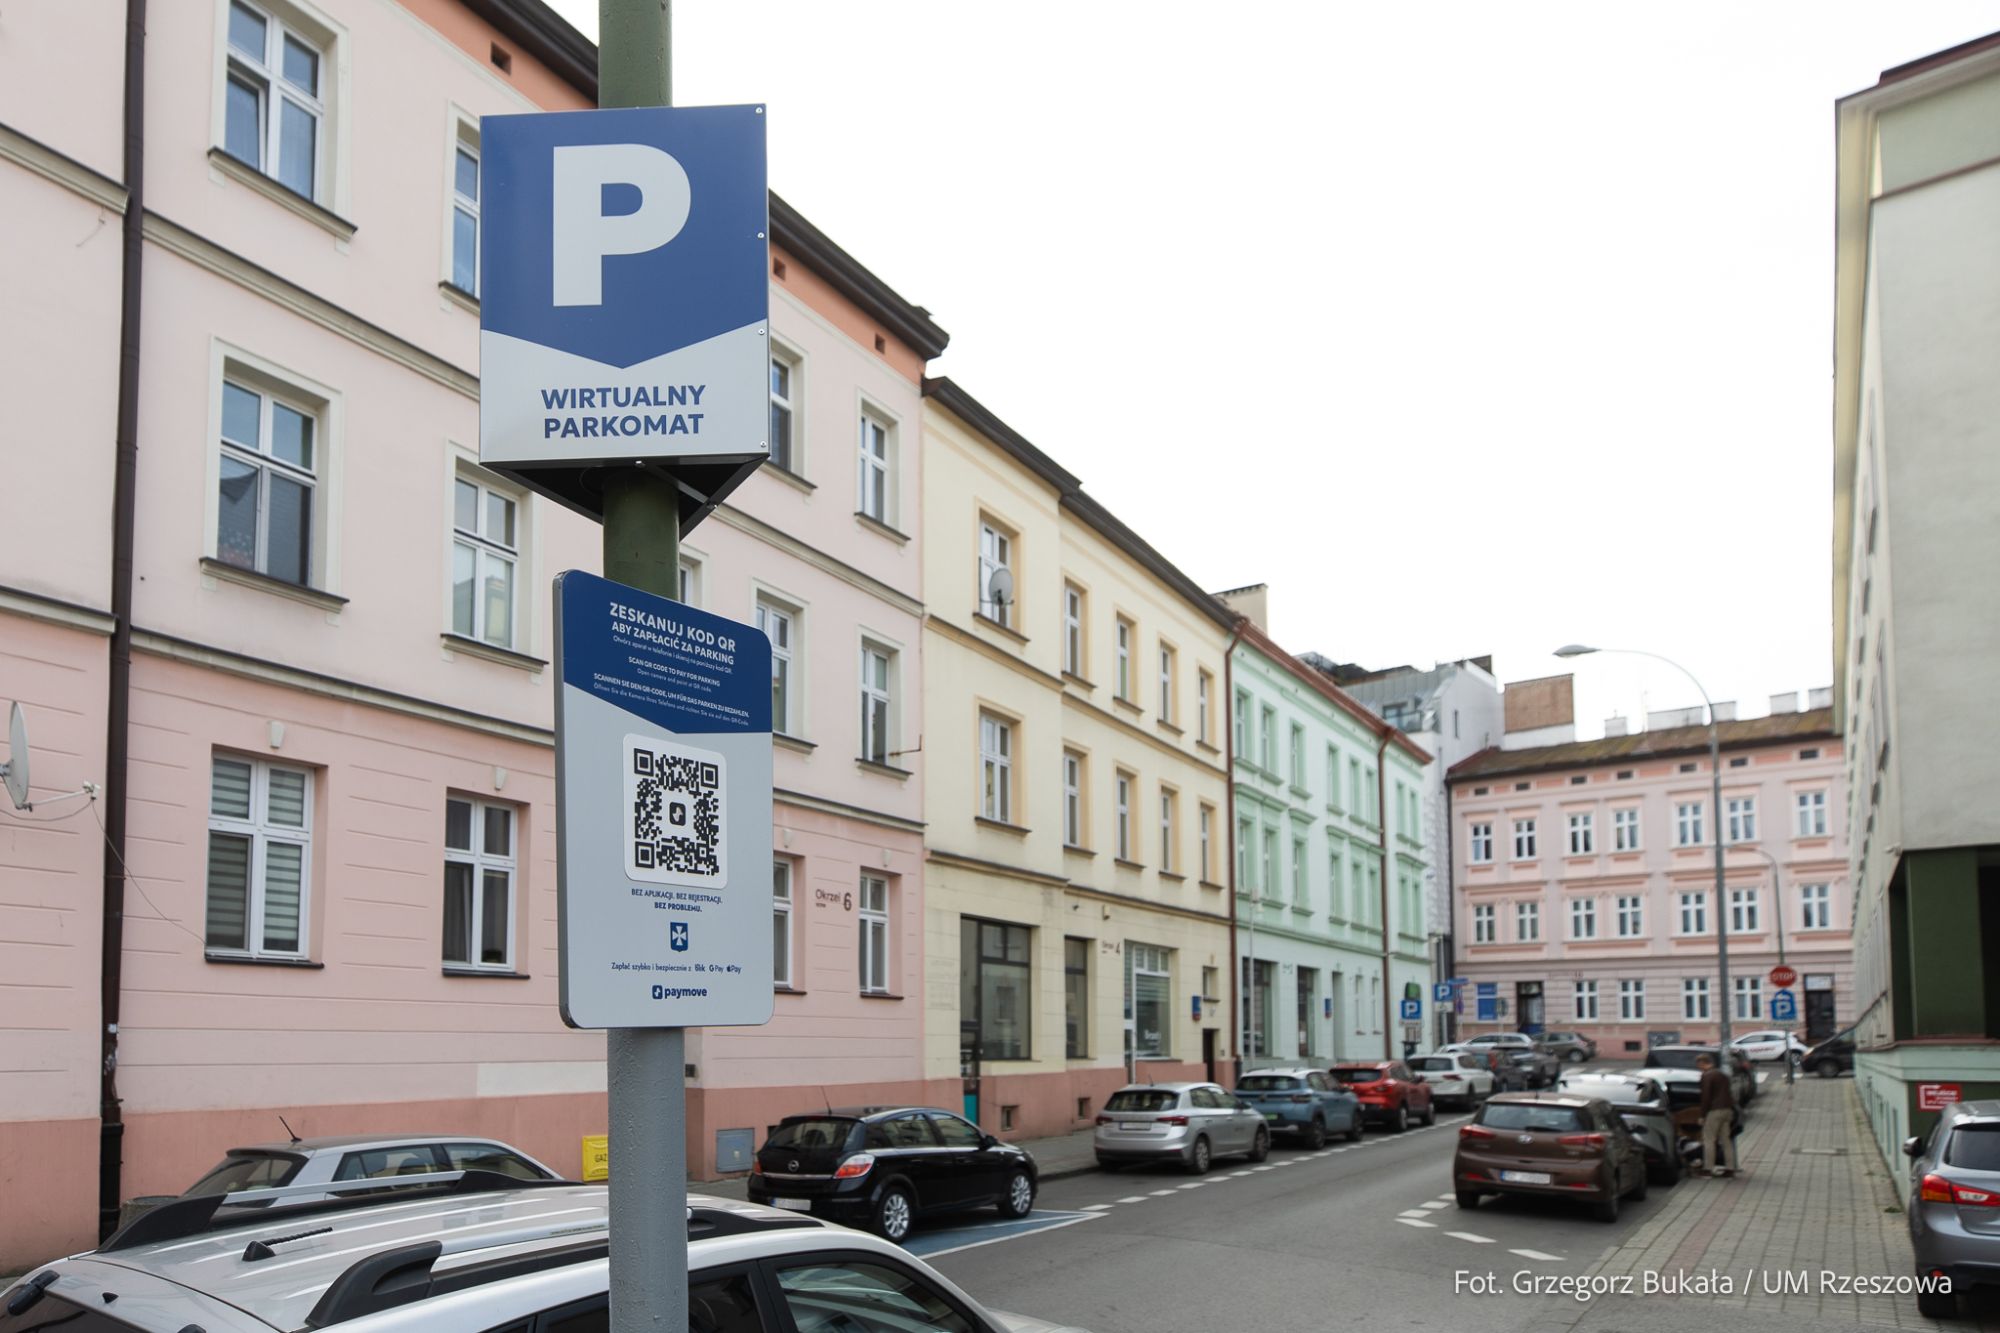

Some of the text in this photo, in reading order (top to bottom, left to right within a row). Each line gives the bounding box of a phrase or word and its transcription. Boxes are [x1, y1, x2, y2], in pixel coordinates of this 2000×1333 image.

[553, 143, 691, 307] P
[541, 385, 706, 410] WIRTUALNY
[544, 413, 704, 439] PARKOMAT
[609, 602, 736, 653] ZESKANUJ KOD QR
[611, 620, 735, 665] ABY ZAPŁACIĆ ZA PARKING
[628, 656, 645, 666] SCAN
[644, 660, 653, 668] QR
[652, 663, 669, 672] CODE
[676, 669, 687, 677] PAY
[686, 672, 698, 680] FOR
[697, 675, 721, 686] PARKING
[593, 672, 621, 685] SCANNEN
[621, 679, 630, 688] SIE
[630, 682, 642, 691] DEN
[642, 685, 668, 697] QR-CODE,
[667, 691, 677, 699] UM
[677, 693, 687, 701] FÜR
[697, 699, 718, 710] PARKEN
[631, 888, 724, 905] BEZ APLIKACJI. BEZ REJESTRACJI.
[654, 901, 703, 913] BEZ PROBLEMU.
[815, 888, 853, 912] Okrzei 6
[611, 961, 631, 972] Zapłać
[631, 963, 651, 972] szybko
[655, 963, 688, 973] bezpiecznie
[664, 987, 708, 999] paymove
[1438, 985, 1451, 999] P
[1405, 1001, 1419, 1017] P
[1775, 1001, 1791, 1016] P
